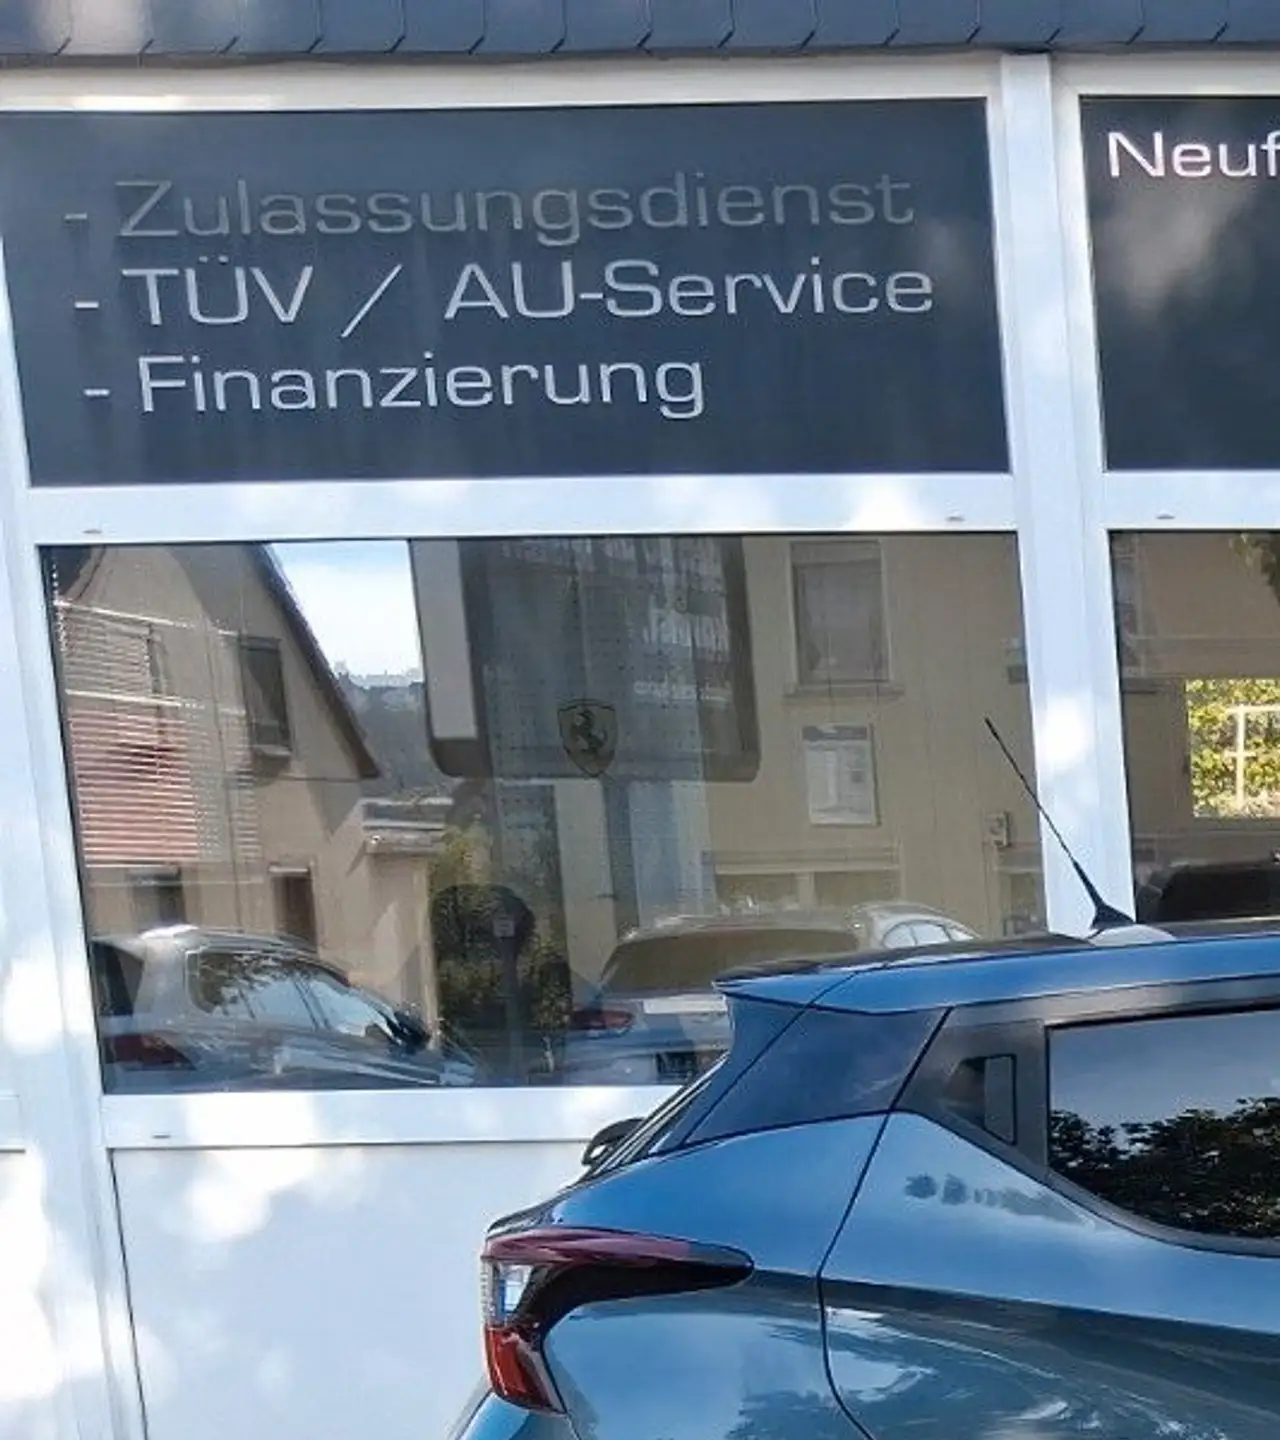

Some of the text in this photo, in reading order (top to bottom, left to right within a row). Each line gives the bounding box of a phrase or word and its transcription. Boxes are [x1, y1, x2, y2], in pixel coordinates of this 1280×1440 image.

[115, 171, 915, 244] Zulassungsdienst
[122, 255, 314, 326] TÜV
[341, 265, 402, 338] /
[444, 257, 933, 321] AU-Service
[138, 353, 704, 420] Finanzierung
